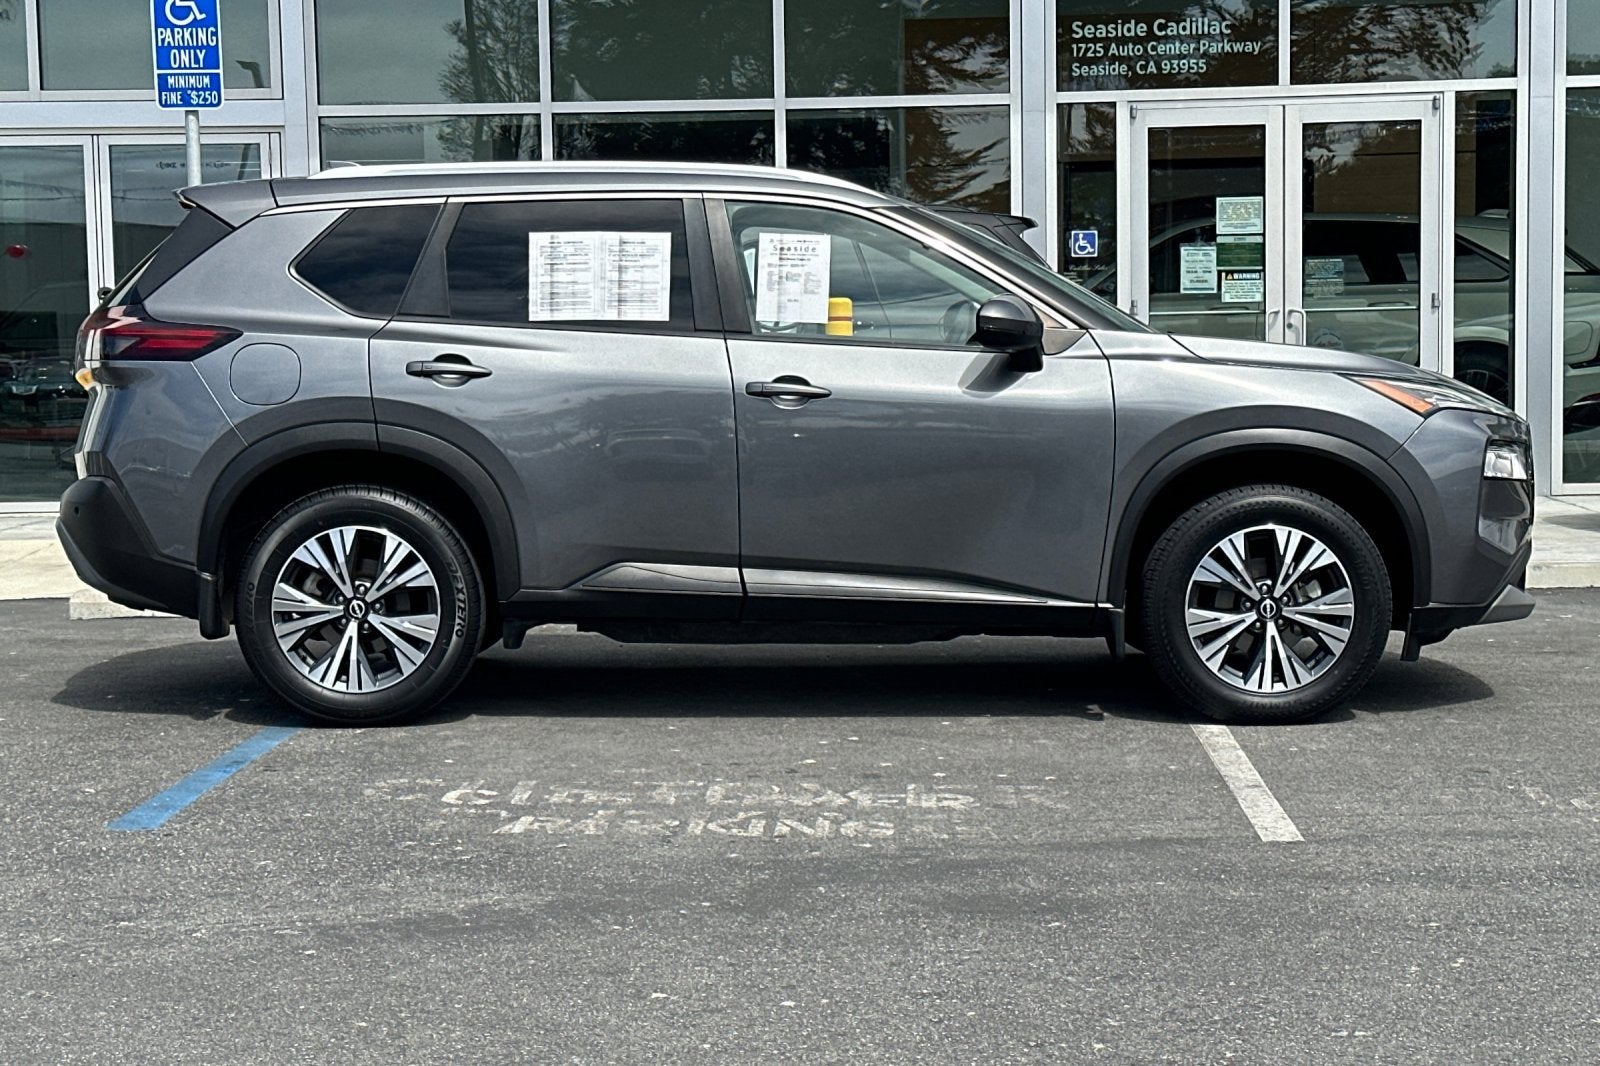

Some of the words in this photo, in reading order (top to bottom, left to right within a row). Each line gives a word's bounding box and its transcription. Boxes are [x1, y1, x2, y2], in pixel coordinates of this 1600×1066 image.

[157, 27, 217, 47] PARKING
[1071, 19, 1148, 38] Seaside
[1153, 17, 1232, 36] Cadillac
[1071, 43, 1104, 58] 1725
[1108, 42, 1144, 57] Auto
[1147, 41, 1195, 56] Center
[1199, 39, 1262, 55] Parkway
[170, 49, 206, 68] ONLY
[1071, 62, 1132, 78] Seaside,
[1136, 60, 1157, 75] CA
[1161, 59, 1207, 74] 93955
[167, 75, 211, 89] MINIMUM
[161, 91, 183, 105] FINE
[190, 90, 219, 105] $250
[773, 245, 817, 253] Seaside
[1233, 272, 1260, 280] WARNING
